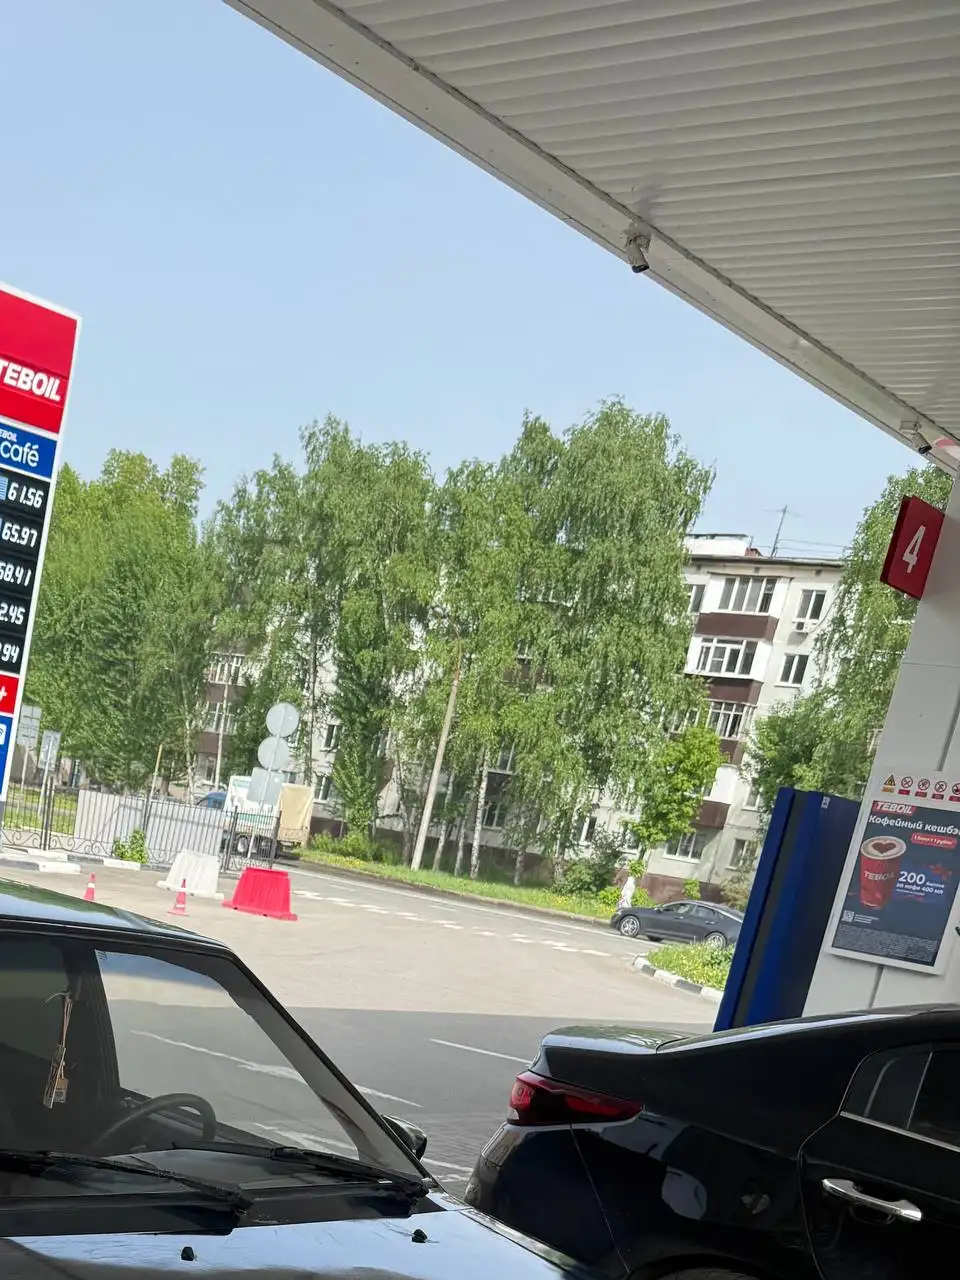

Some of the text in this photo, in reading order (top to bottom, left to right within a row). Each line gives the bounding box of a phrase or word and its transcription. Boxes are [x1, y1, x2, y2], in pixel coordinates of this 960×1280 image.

[0, 441, 40, 468] café
[7, 482, 44, 508] 61.56
[1, 522, 38, 548] 65.97
[902, 525, 927, 574] 4
[875, 801, 913, 814] TEBOIL
[869, 815, 960, 835] Кофейный кешбэ
[898, 871, 926, 885] 200
